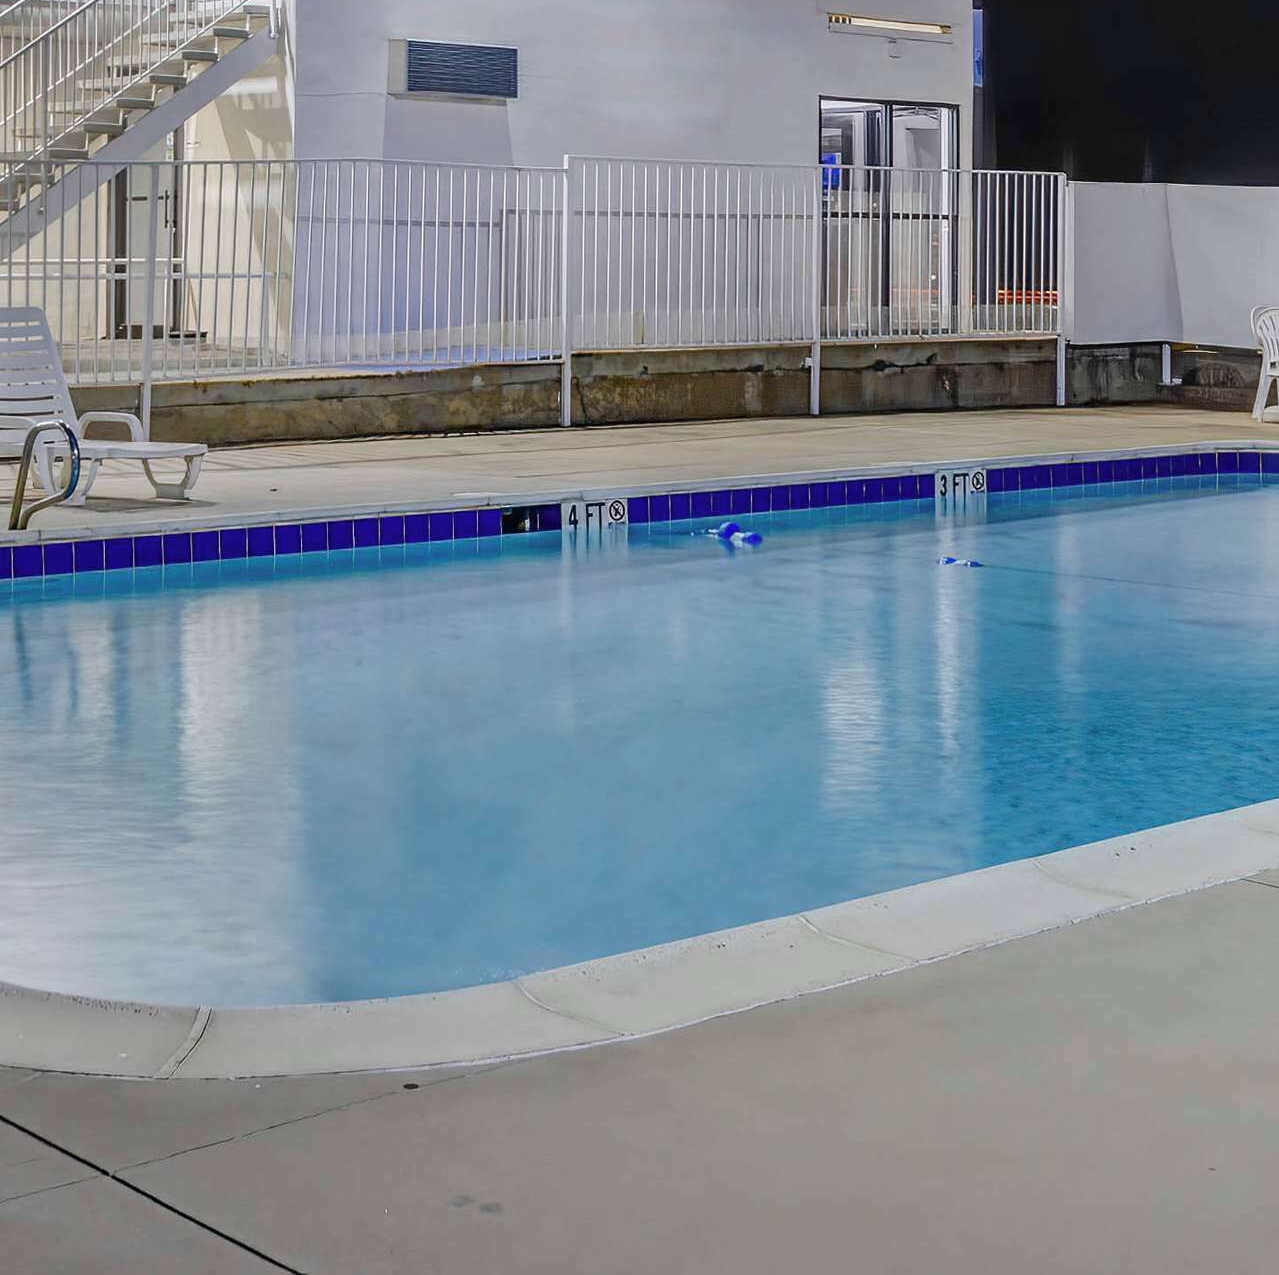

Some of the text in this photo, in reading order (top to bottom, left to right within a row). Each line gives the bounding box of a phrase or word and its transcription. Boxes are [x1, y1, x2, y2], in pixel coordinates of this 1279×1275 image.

[940, 473, 969, 496] 3 FT
[568, 502, 606, 529] 4 FT
